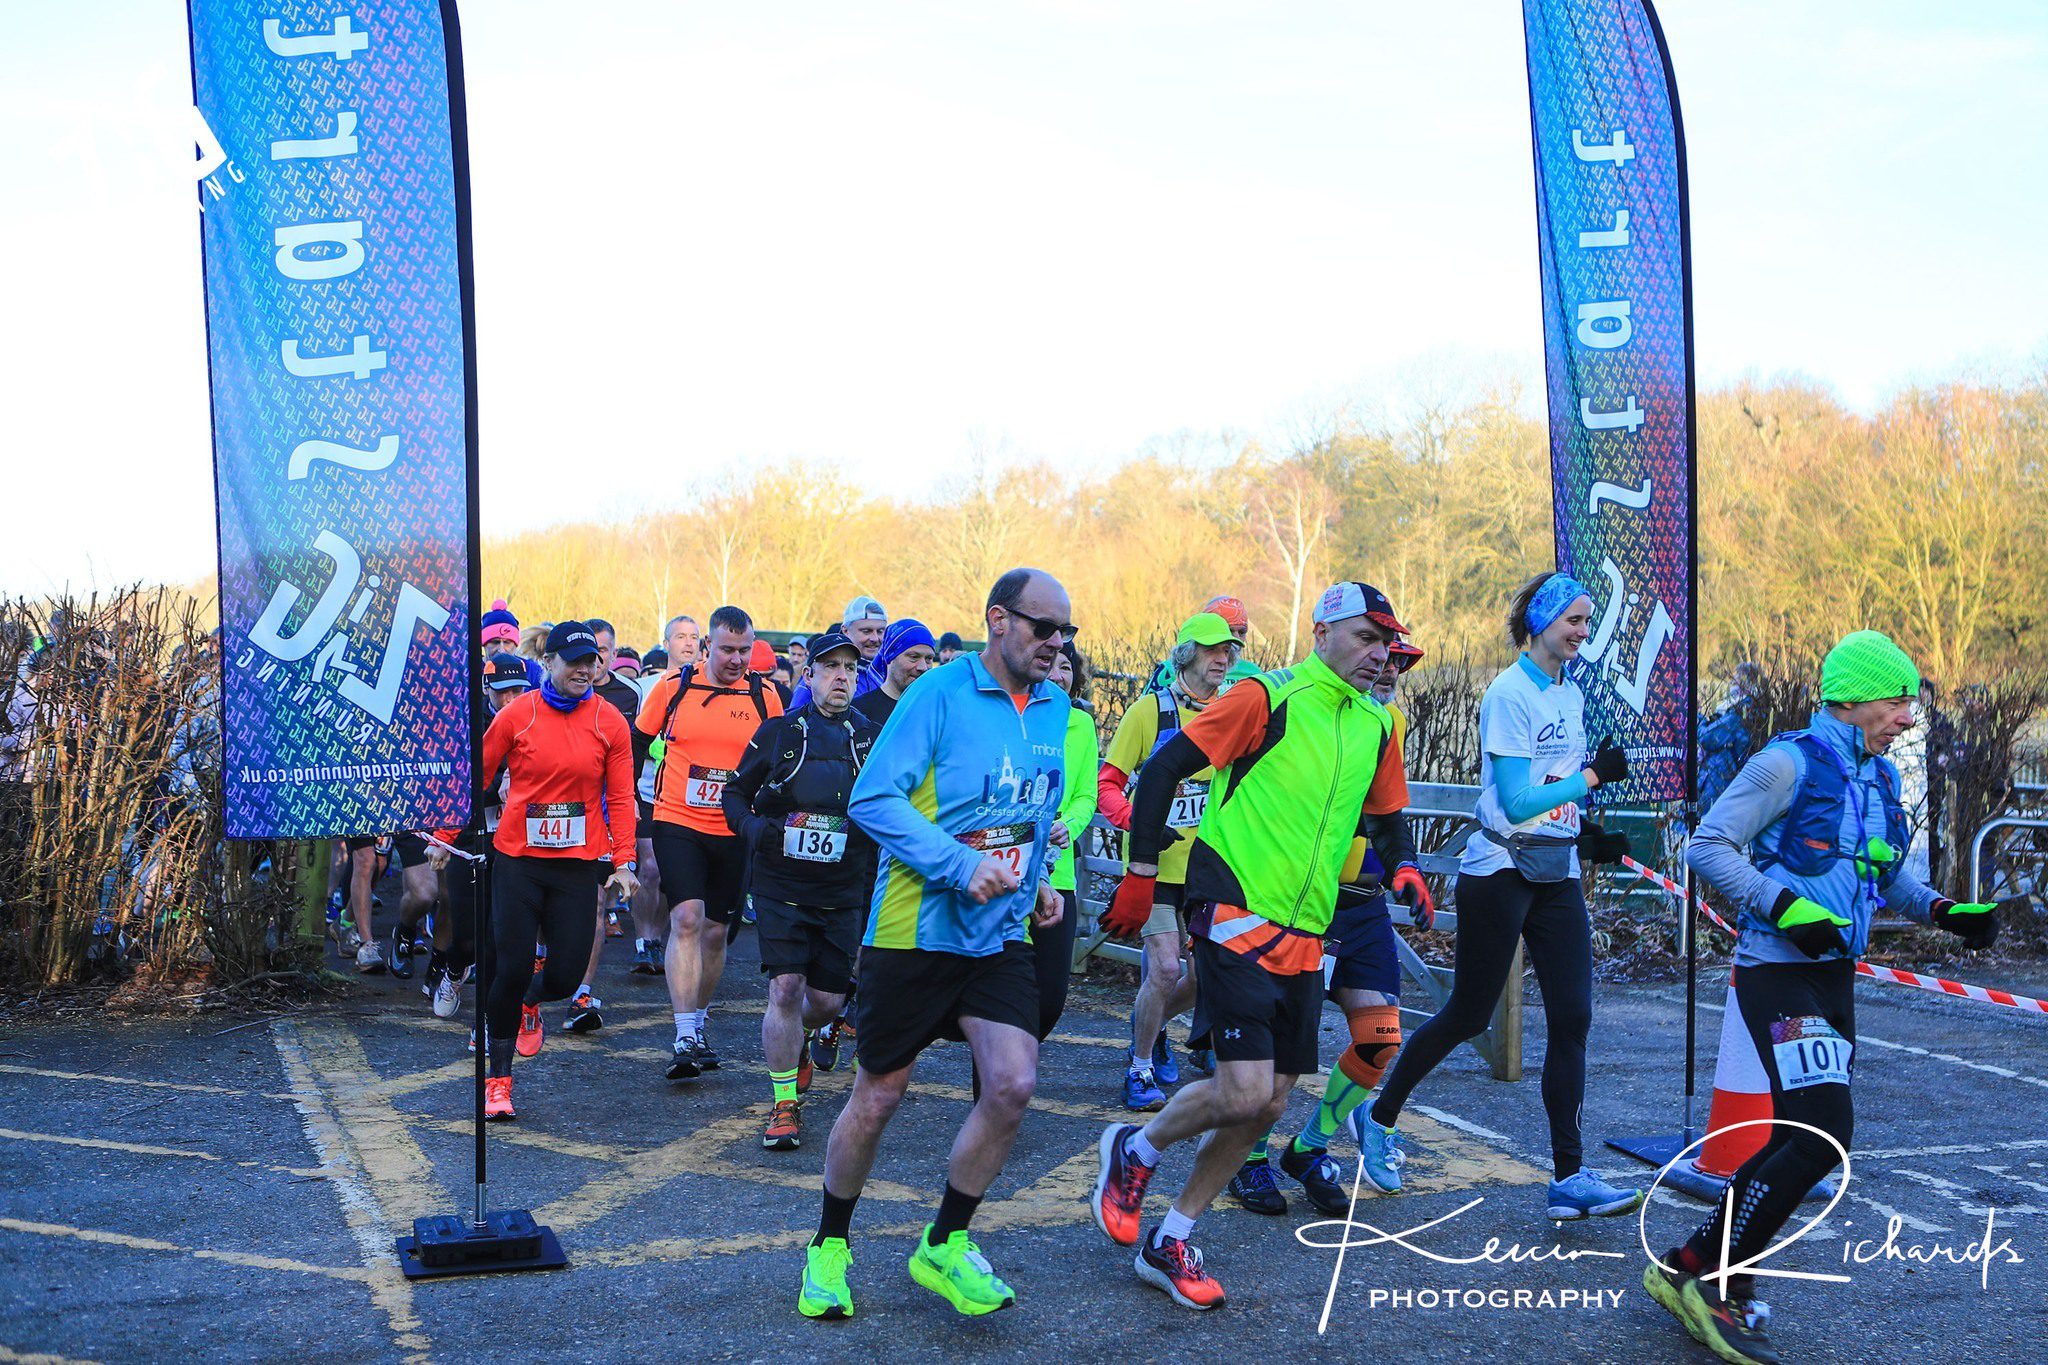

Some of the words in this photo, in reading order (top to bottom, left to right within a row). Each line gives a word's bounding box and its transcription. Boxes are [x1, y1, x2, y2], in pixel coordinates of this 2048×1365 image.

[975, 806, 1016, 817] Chester
[538, 819, 571, 841] 441
[797, 830, 833, 856] 136
[1797, 1040, 1841, 1074] 101
